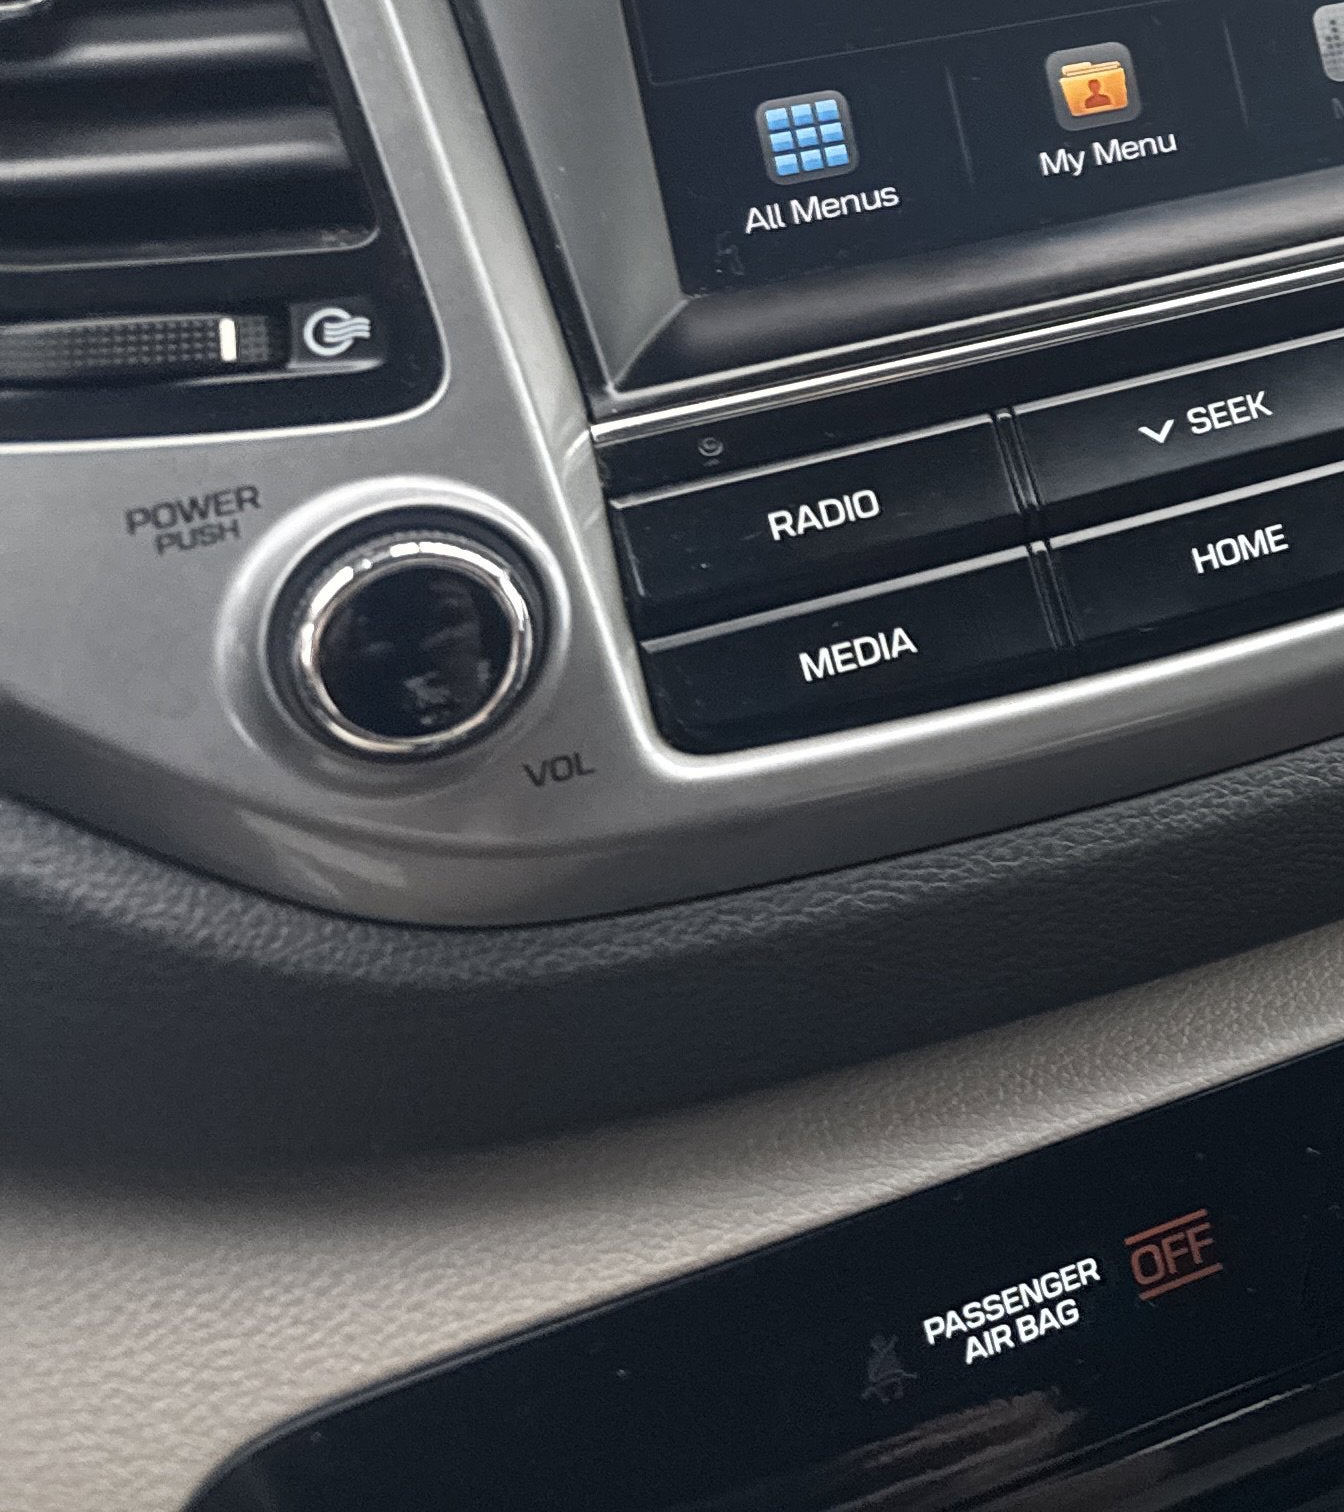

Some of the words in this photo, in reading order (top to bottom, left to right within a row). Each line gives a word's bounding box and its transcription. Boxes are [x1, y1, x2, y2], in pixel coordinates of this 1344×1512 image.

[1039, 147, 1086, 178] My
[1093, 132, 1177, 166] Menu
[744, 202, 786, 236] All
[791, 185, 900, 226] Menus
[1185, 391, 1273, 436] SEEK
[124, 485, 262, 536] POWER
[767, 489, 881, 541] RADIO
[155, 519, 241, 556] PUSH
[1191, 523, 1289, 574] HOME
[799, 627, 918, 682] MEDIA
[522, 752, 597, 788] VOL
[1130, 1222, 1214, 1286] OFF
[922, 1257, 1101, 1346] PASSENGER
[965, 1324, 1016, 1366] AIR
[1015, 1299, 1080, 1344] BAG
